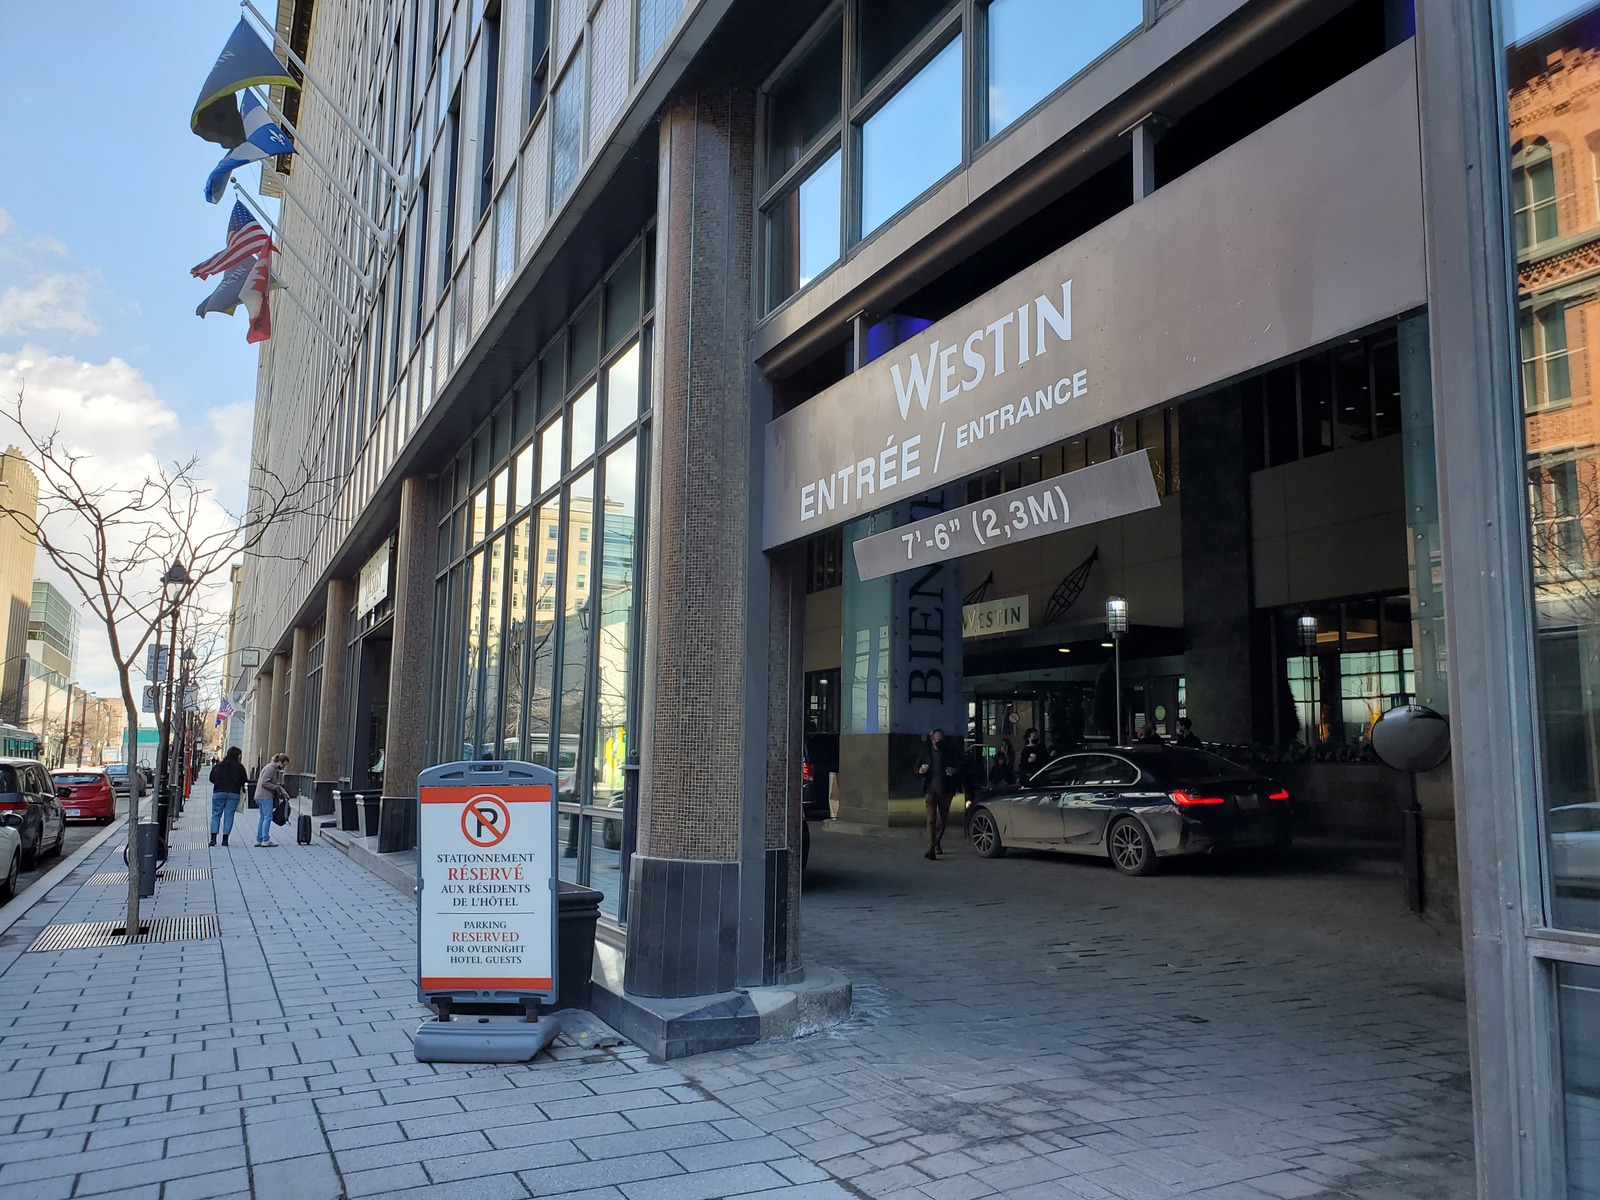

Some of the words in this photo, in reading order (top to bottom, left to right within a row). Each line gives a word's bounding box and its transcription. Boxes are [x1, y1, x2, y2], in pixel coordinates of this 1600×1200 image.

[890, 279, 1073, 421] WESTIN
[800, 434, 922, 522] ENTRÉE
[933, 422, 947, 473] /
[957, 369, 1088, 448] ENTRANCE
[972, 485, 1071, 545] (2,3M)
[437, 853, 535, 863] STATIONNEMENT
[447, 864, 525, 881] RÉSERVÉ
[441, 884, 465, 894] AUX
[468, 882, 531, 894] RÉSIDENTS
[452, 897, 468, 907] DE
[463, 921, 507, 930] PARKING
[452, 931, 520, 942] RESERVED
[446, 945, 465, 954] FOR
[467, 945, 526, 954] OVERNIGHT
[450, 955, 483, 964] HOTEL
[485, 955, 522, 964] GUESTS
